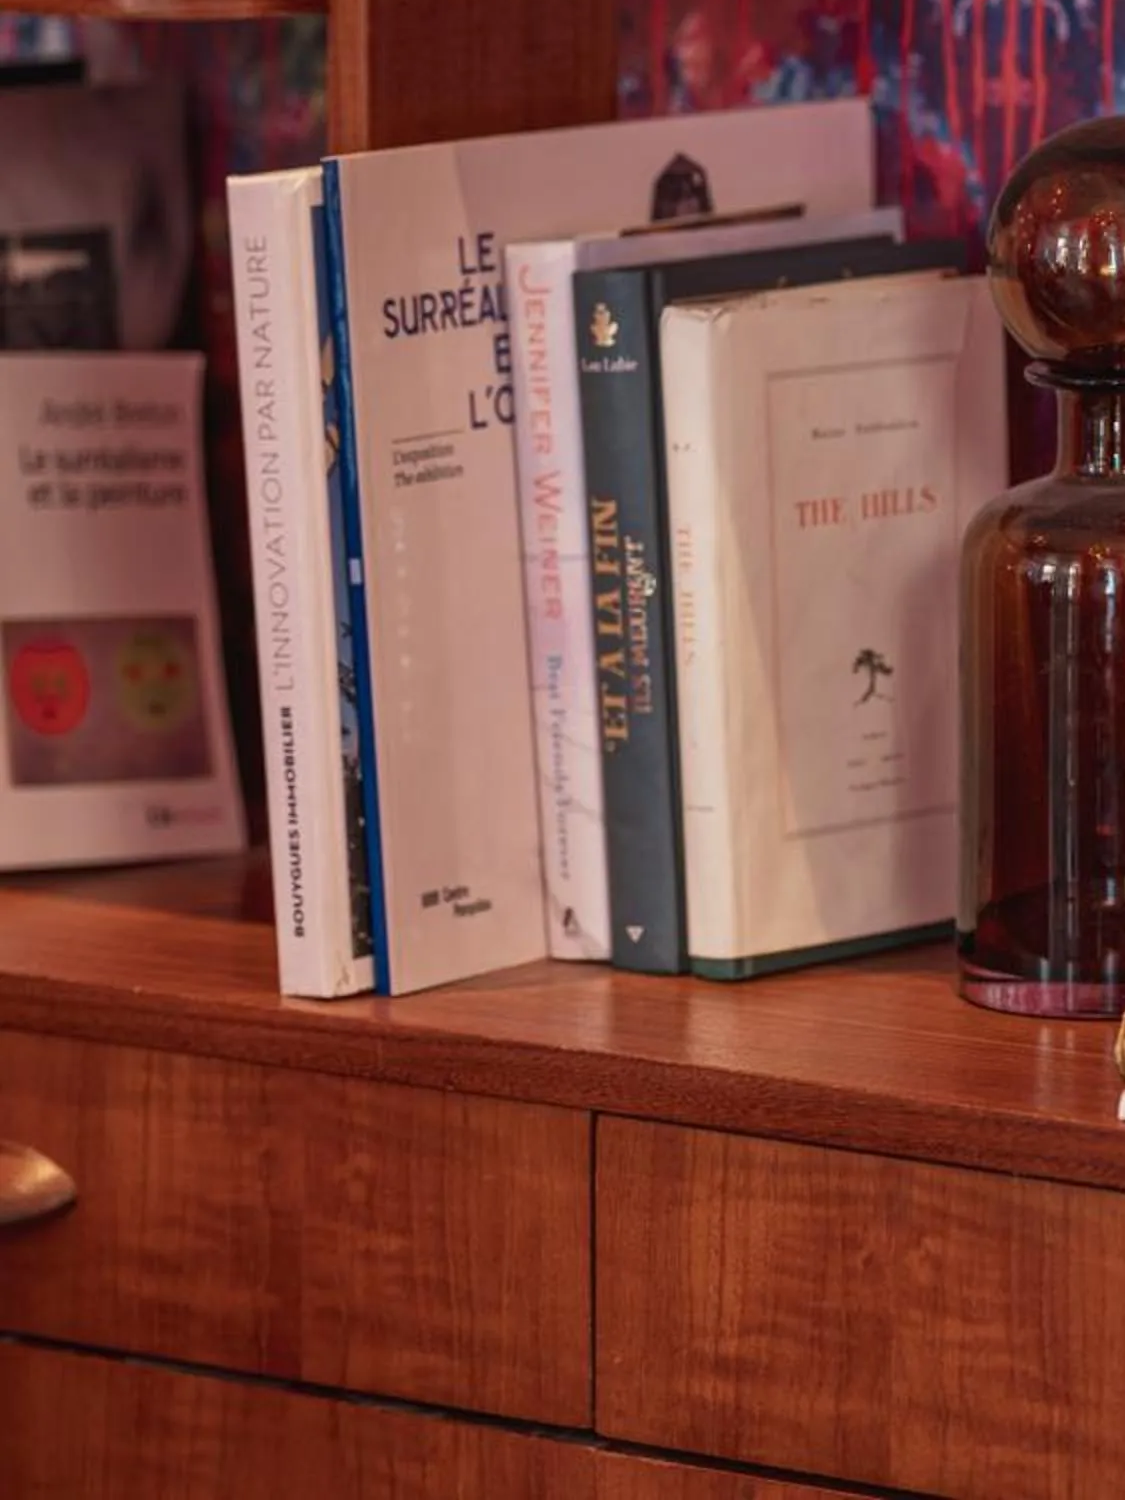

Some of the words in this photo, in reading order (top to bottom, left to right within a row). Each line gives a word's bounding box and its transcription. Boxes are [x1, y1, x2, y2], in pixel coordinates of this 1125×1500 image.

[244, 234, 273, 369] NATURE
[383, 278, 508, 340] SURRÉAL
[458, 233, 496, 276] LE
[493, 333, 511, 374] E
[517, 263, 553, 455] JENNIFER
[255, 378, 278, 441] PAR
[533, 469, 564, 620] WEINER
[795, 497, 846, 529] THE
[860, 484, 938, 521] HILLS
[260, 451, 295, 692] L'INNOVATION
[279, 706, 299, 825] IMMOBILIER
[287, 829, 306, 938] BOUYGUES
